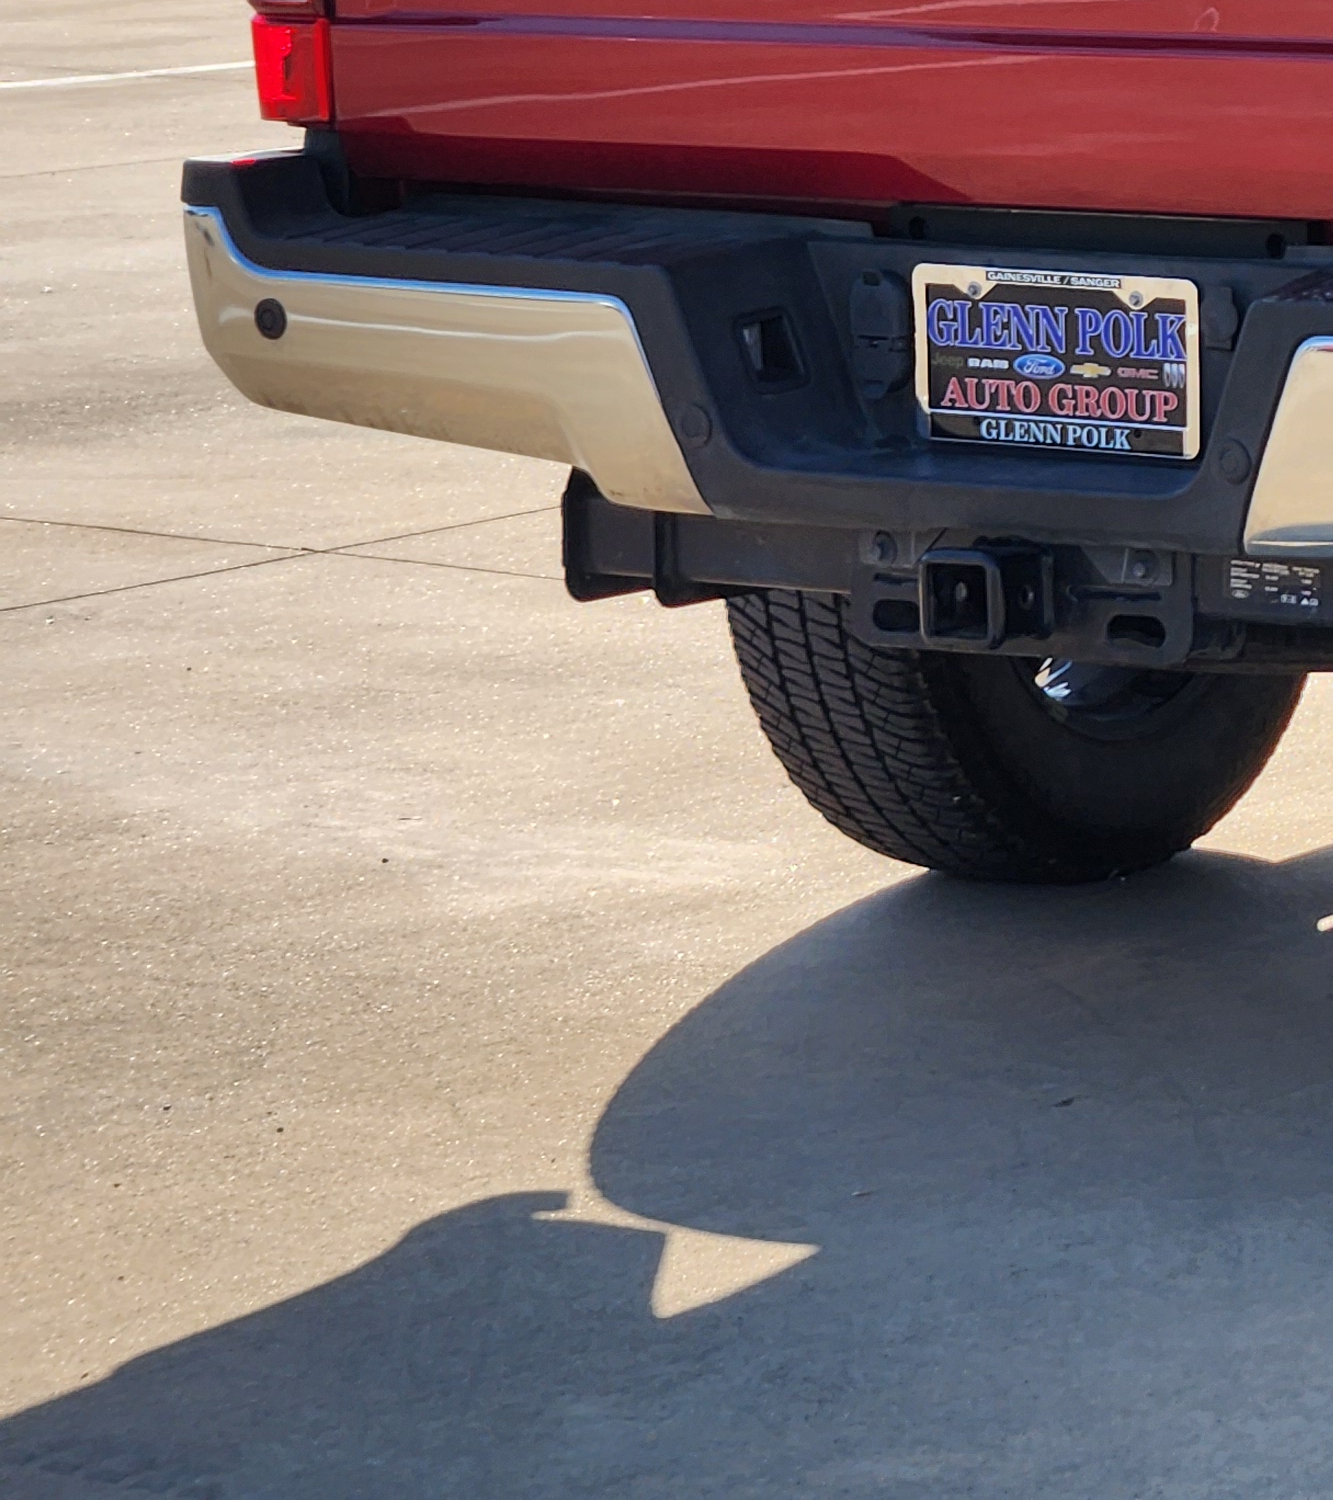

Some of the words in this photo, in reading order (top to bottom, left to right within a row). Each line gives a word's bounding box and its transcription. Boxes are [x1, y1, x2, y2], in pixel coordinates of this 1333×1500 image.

[987, 270, 1062, 285] GAINESVILLE
[1070, 276, 1121, 288] SANGER
[927, 298, 1068, 354] GLENN
[1075, 307, 1187, 361] POLK
[1117, 367, 1159, 380] GMC
[940, 376, 1042, 413] AUTO
[1048, 382, 1179, 423] GROUP
[980, 417, 1063, 444] GLENN
[1066, 425, 1132, 451] POLK
